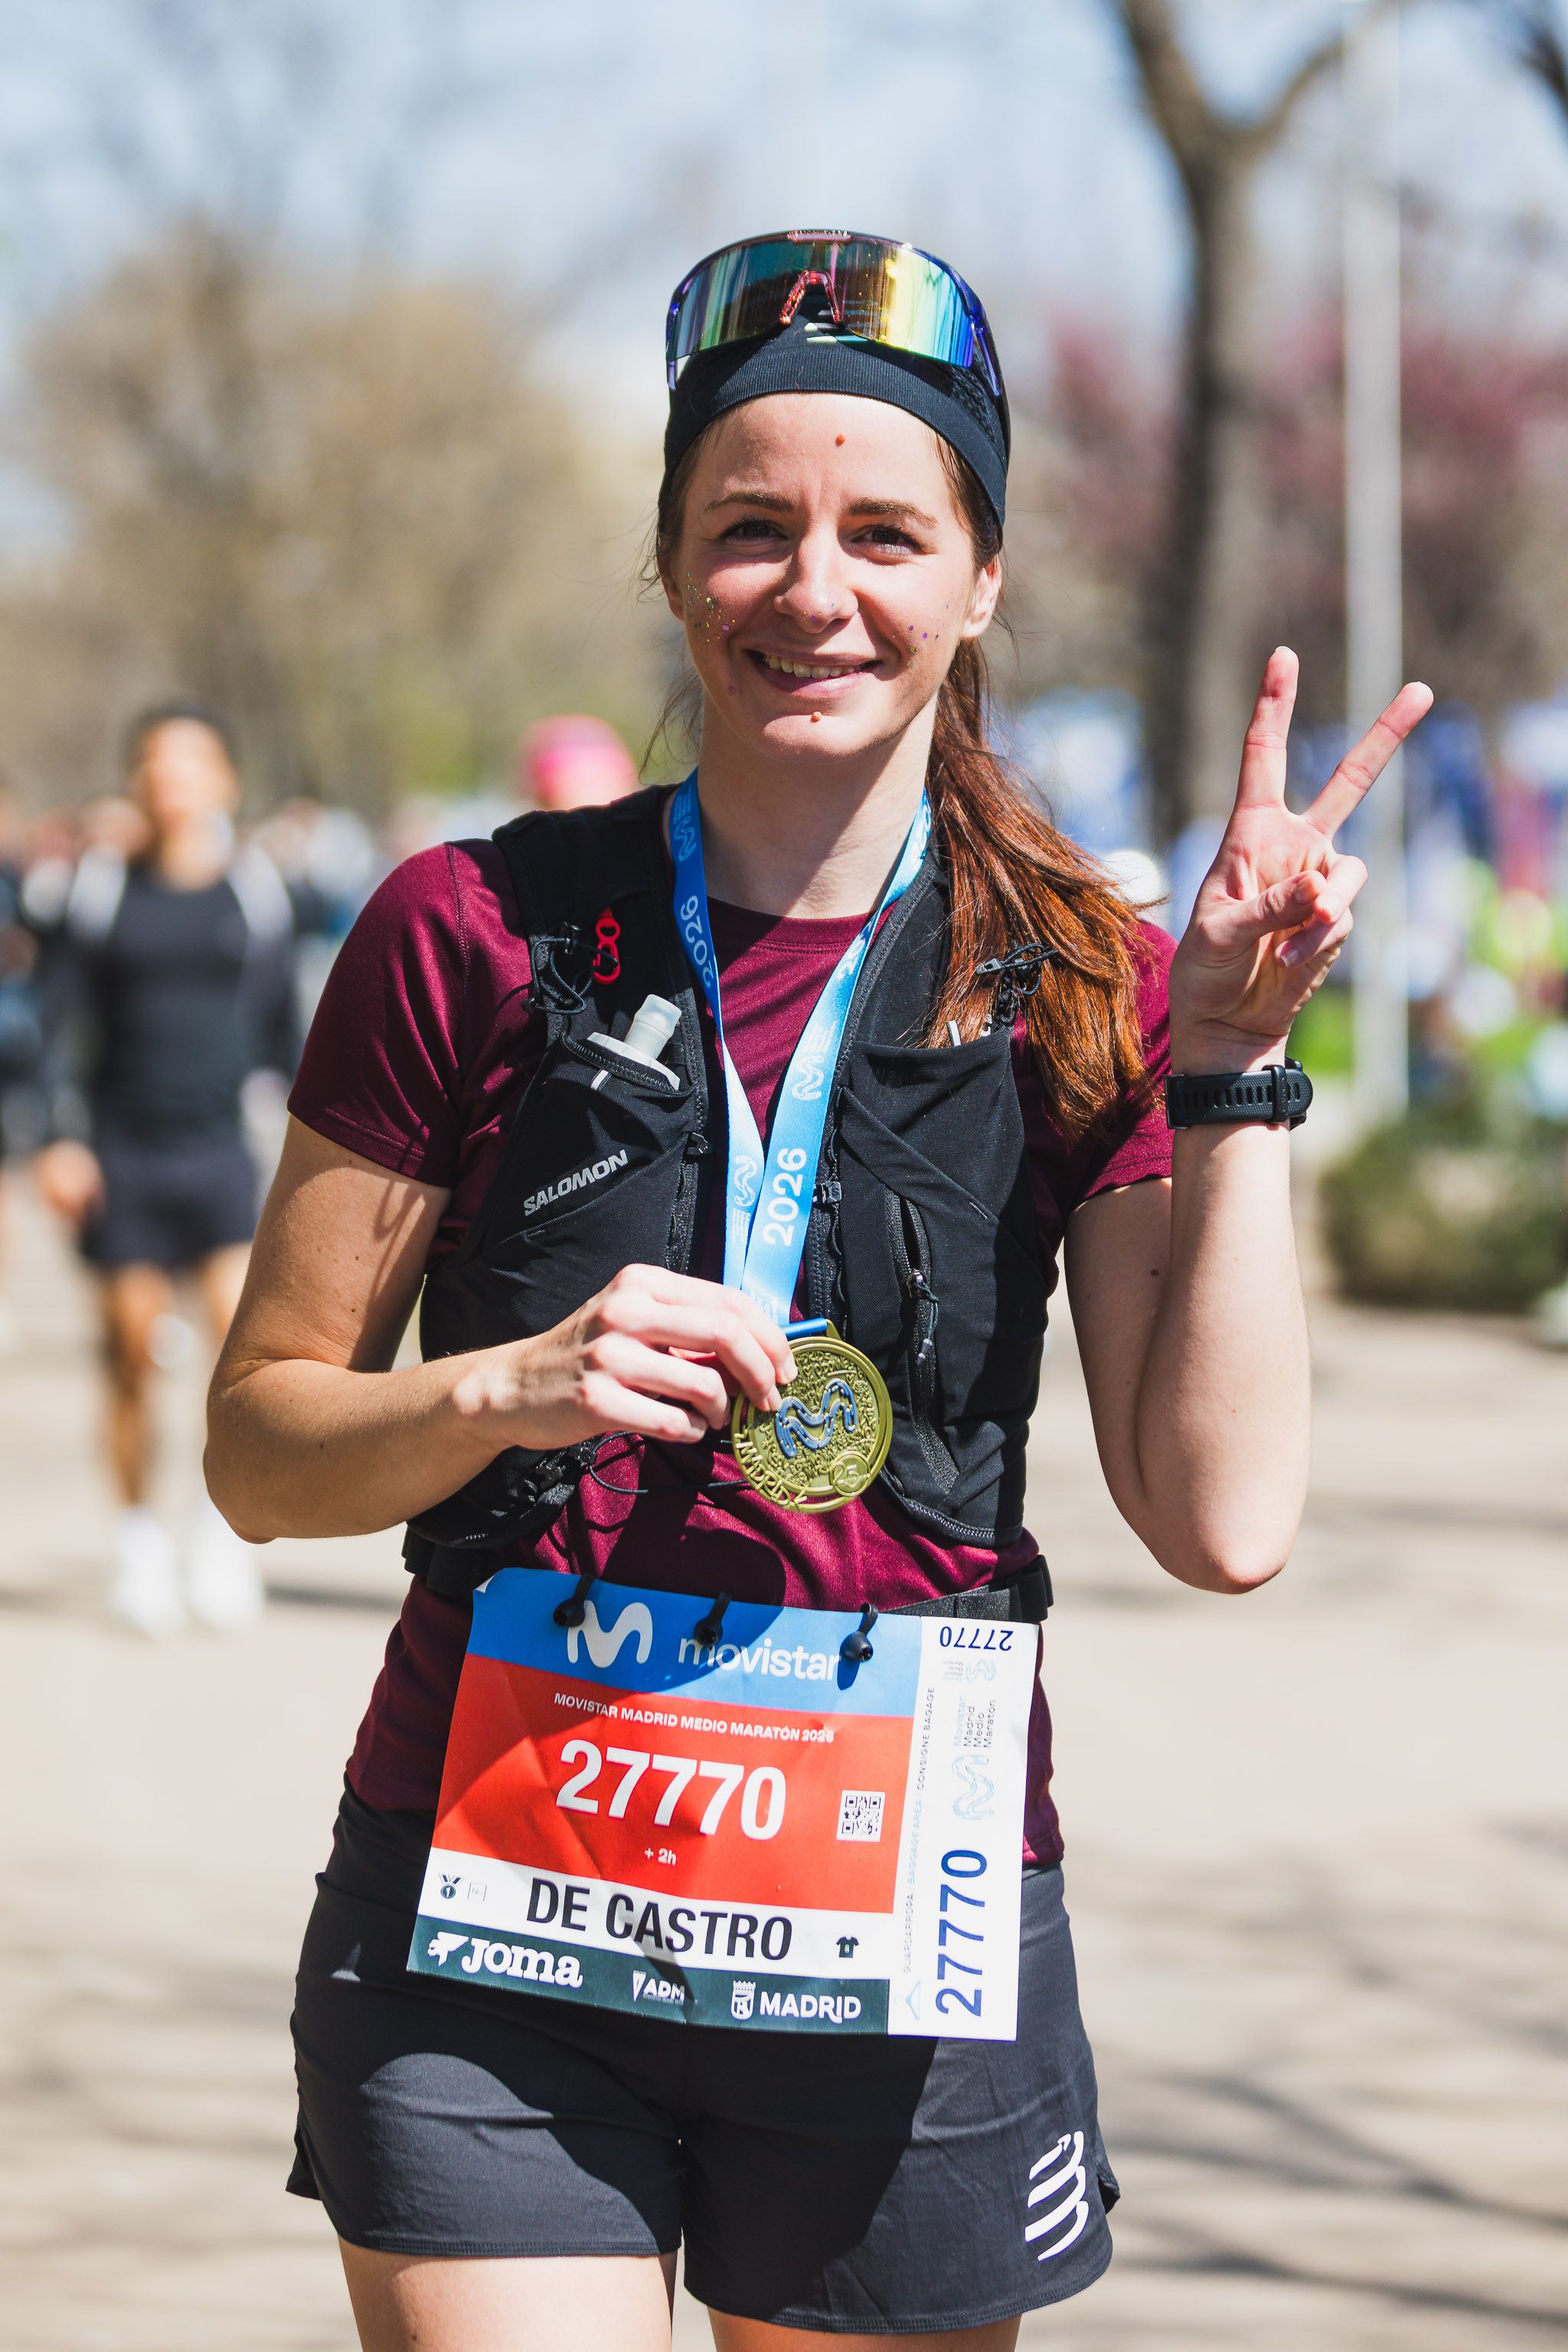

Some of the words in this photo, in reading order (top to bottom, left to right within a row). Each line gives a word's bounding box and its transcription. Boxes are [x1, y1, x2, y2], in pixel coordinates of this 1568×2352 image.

[680, 895, 714, 988] 2026
[523, 1149, 629, 1217] SALOMON
[762, 1148, 807, 1247] 2026
[678, 1638, 841, 1681] movistar
[939, 1626, 1014, 1651] 27770
[554, 1692, 618, 1719] MOVISTAR
[620, 1707, 678, 1727] MADRID
[680, 1716, 728, 1734] MEDIO
[730, 1722, 800, 1742] MARATÓN
[802, 1729, 835, 1743] 2026
[917, 1735, 929, 1790] CONSIGNE
[923, 1687, 935, 1730] BAGAGE
[963, 1706, 975, 1747] Madrid
[973, 1712, 985, 1747] Medio
[556, 1739, 786, 1841] 27770
[658, 1847, 677, 1866] 2h
[527, 1877, 590, 1932] DE
[606, 1893, 792, 1961] CASTRO
[936, 1850, 988, 2017] 27770
[643, 1977, 685, 2001] ADM
[760, 1991, 862, 2024] MADRID
